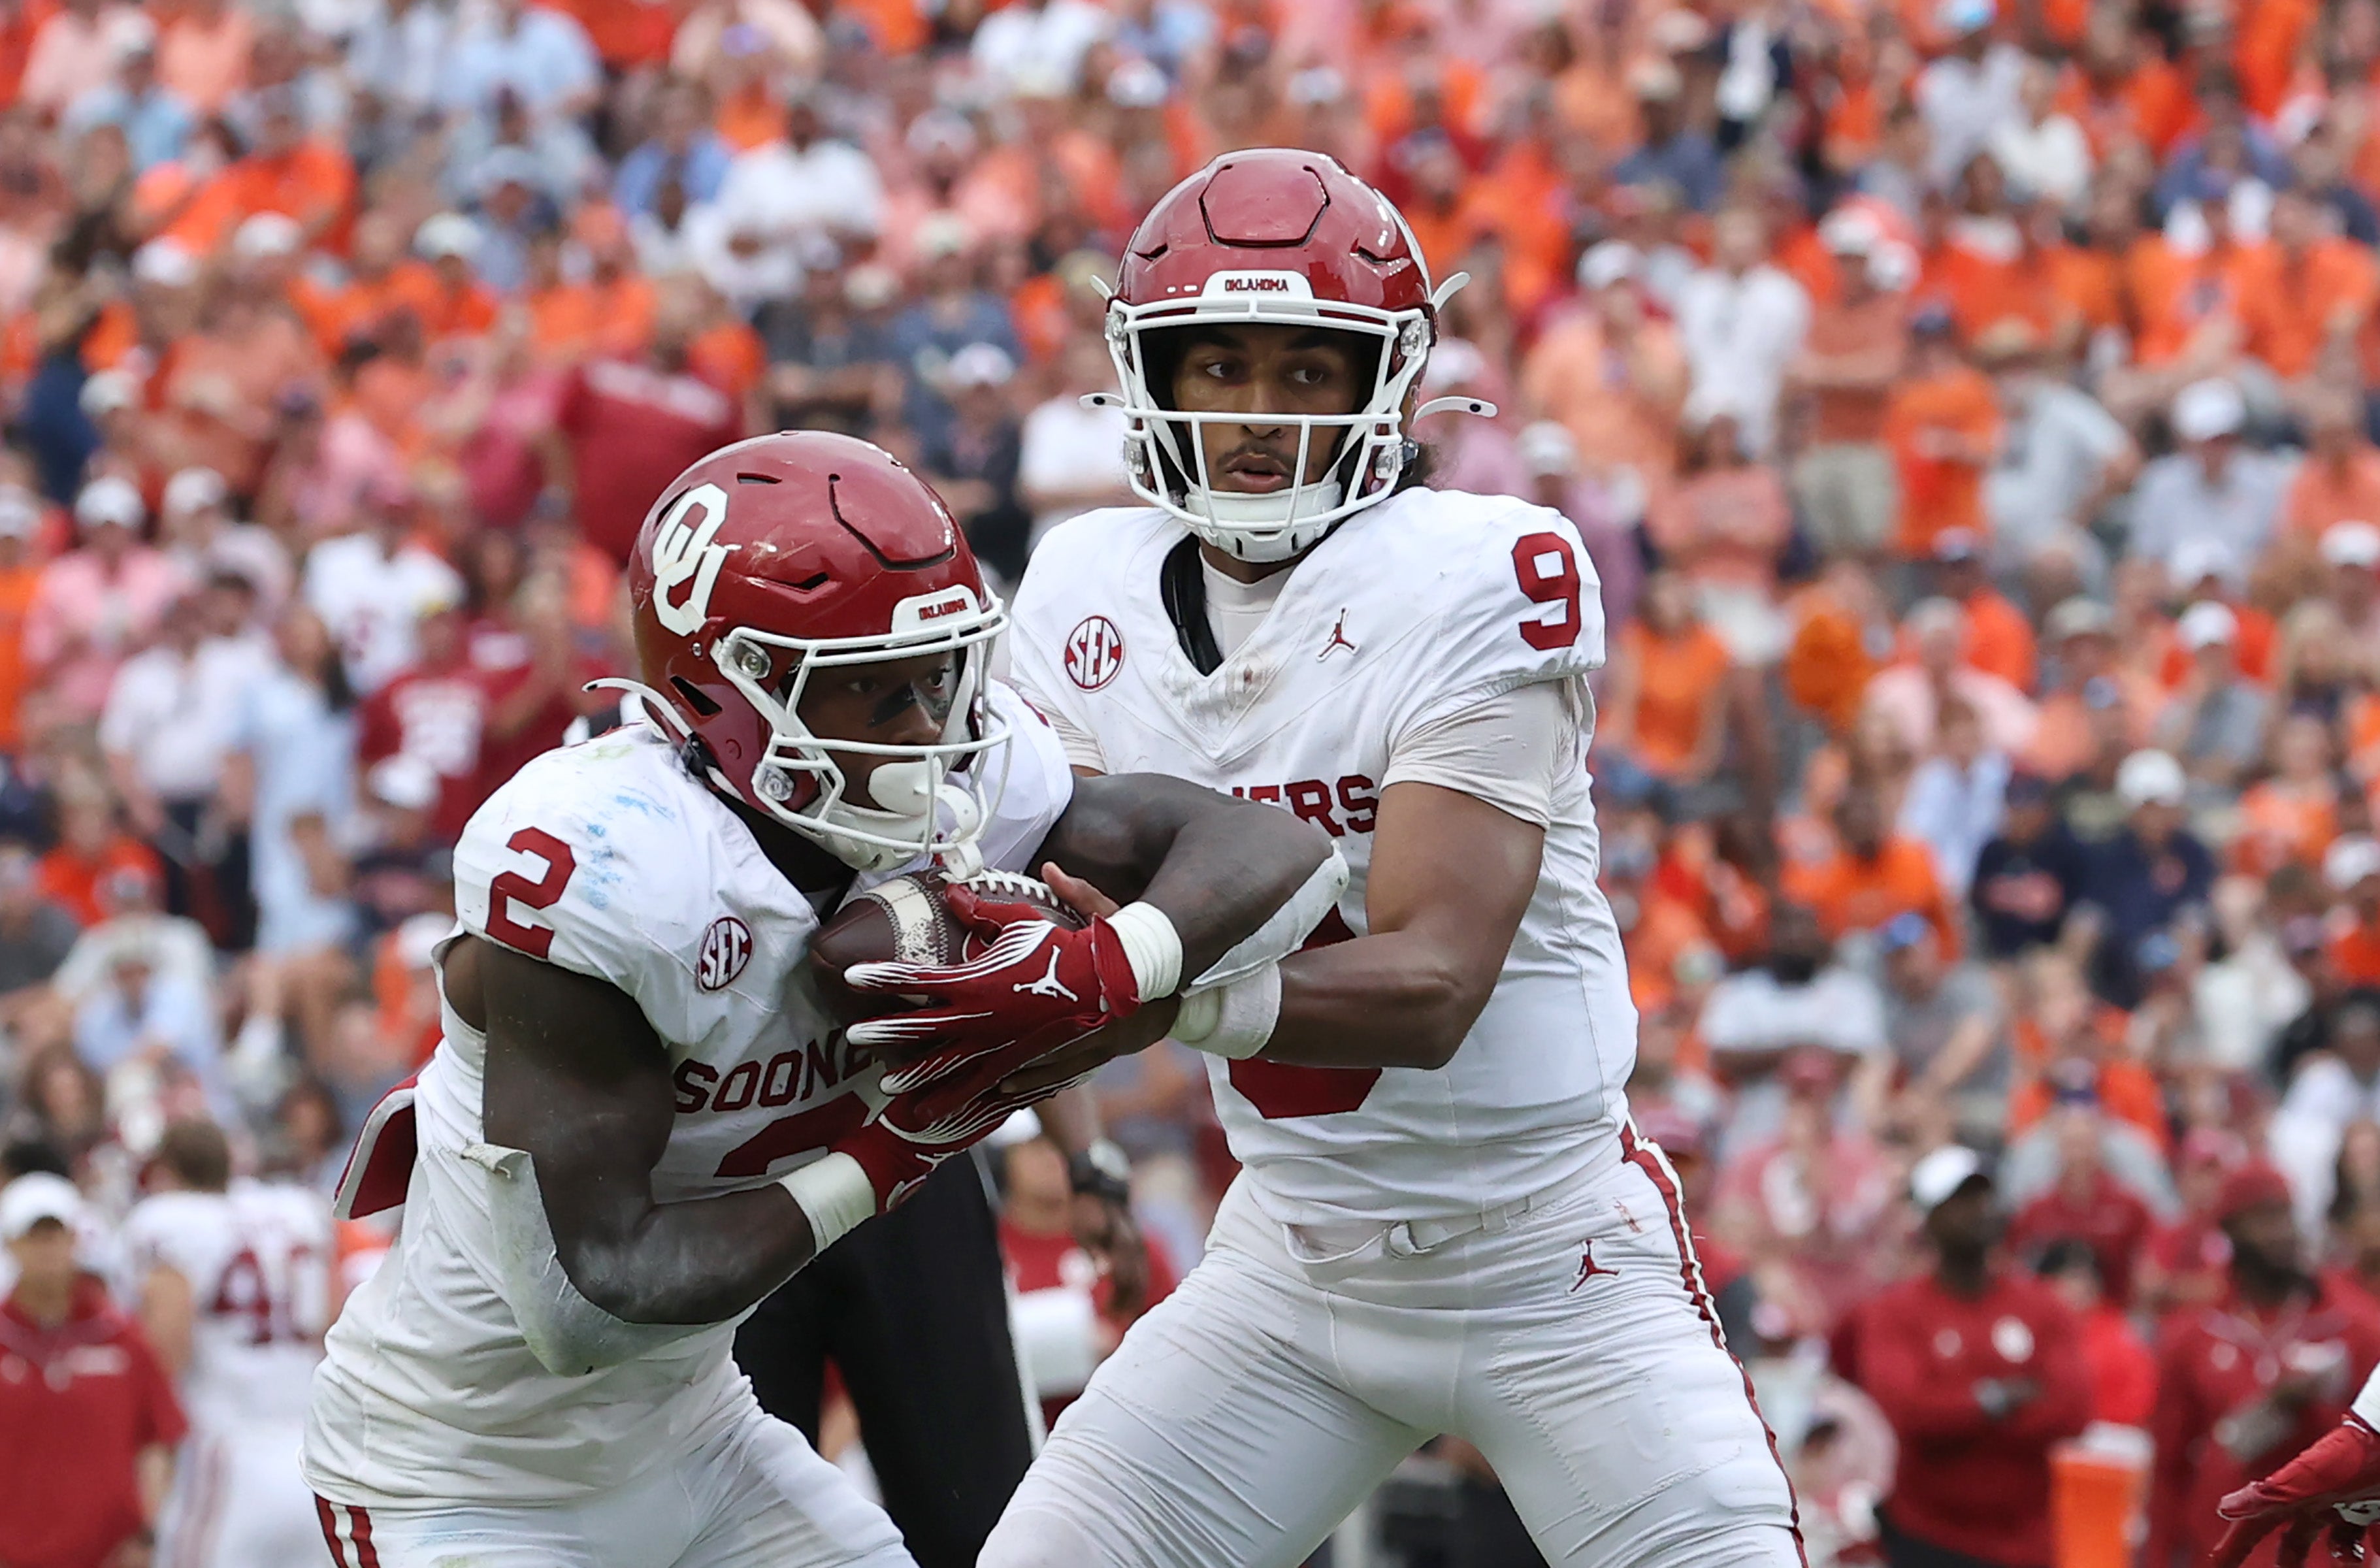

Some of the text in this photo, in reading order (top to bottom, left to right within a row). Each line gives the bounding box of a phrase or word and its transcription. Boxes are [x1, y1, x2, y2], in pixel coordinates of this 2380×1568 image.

[1224, 278, 1289, 291] OKLAHOMA
[1510, 531, 1581, 651] 9
[1065, 616, 1122, 689] SEC
[485, 826, 576, 959] 2
[701, 917, 752, 988] SEC
